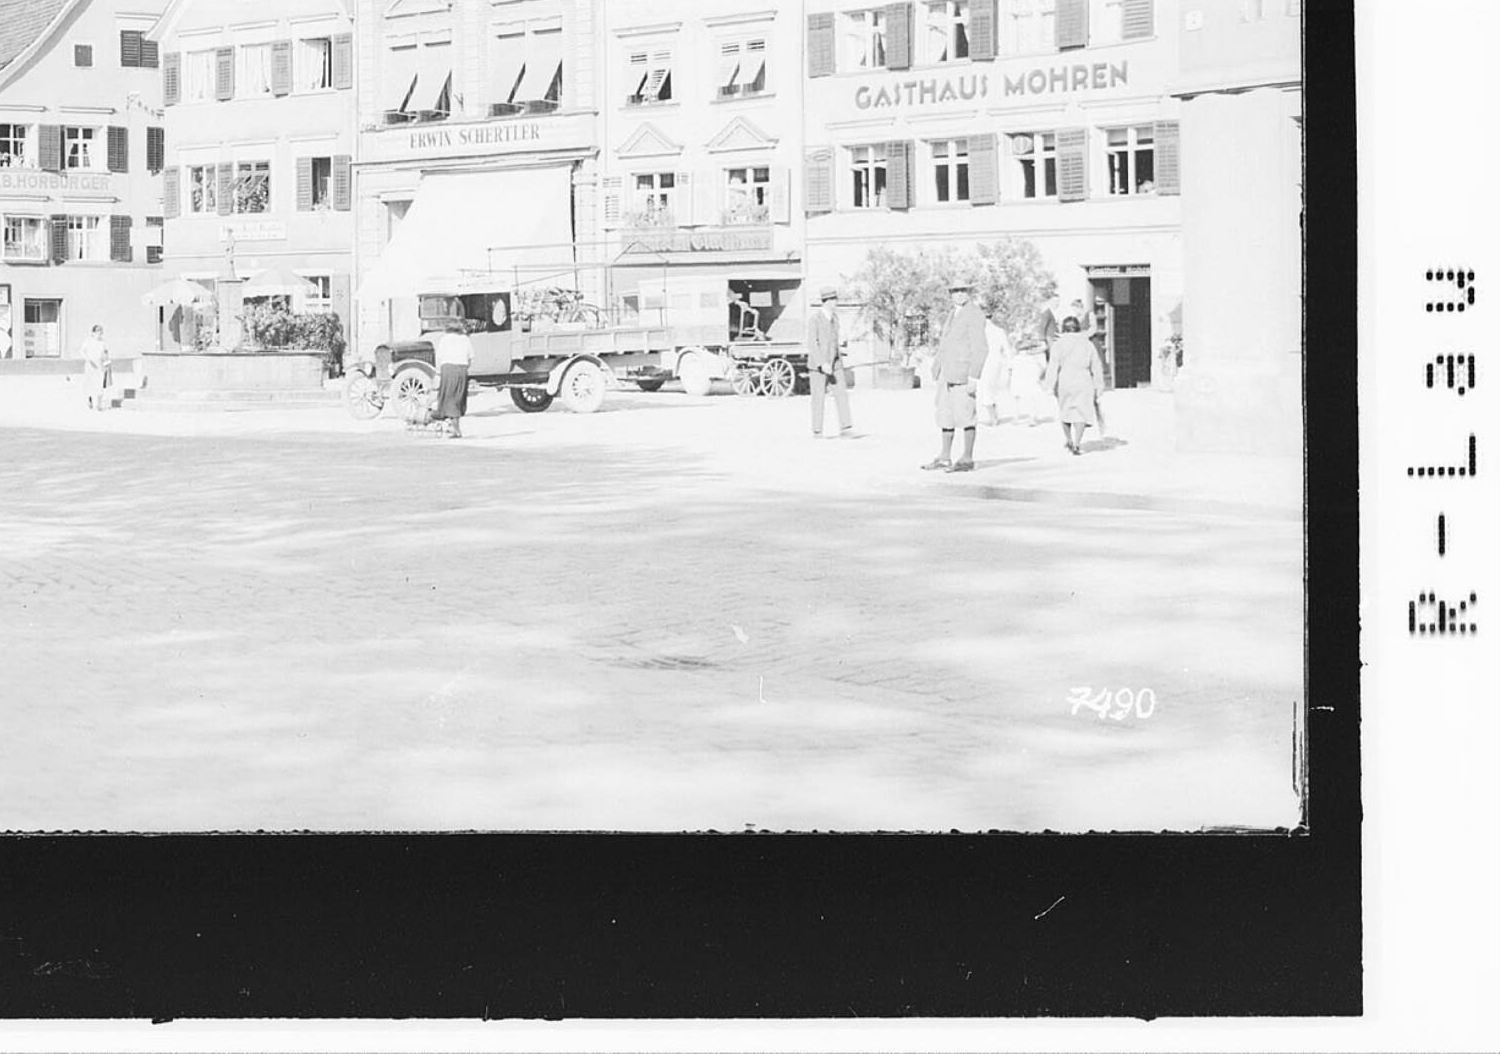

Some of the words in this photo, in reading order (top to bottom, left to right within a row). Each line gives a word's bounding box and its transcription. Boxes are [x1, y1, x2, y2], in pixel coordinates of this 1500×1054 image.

[855, 75, 988, 110] GASTHAUS
[1004, 61, 1129, 97] MOHREN
[410, 130, 451, 149] ERWIN
[459, 124, 540, 145] SCHERTLER
